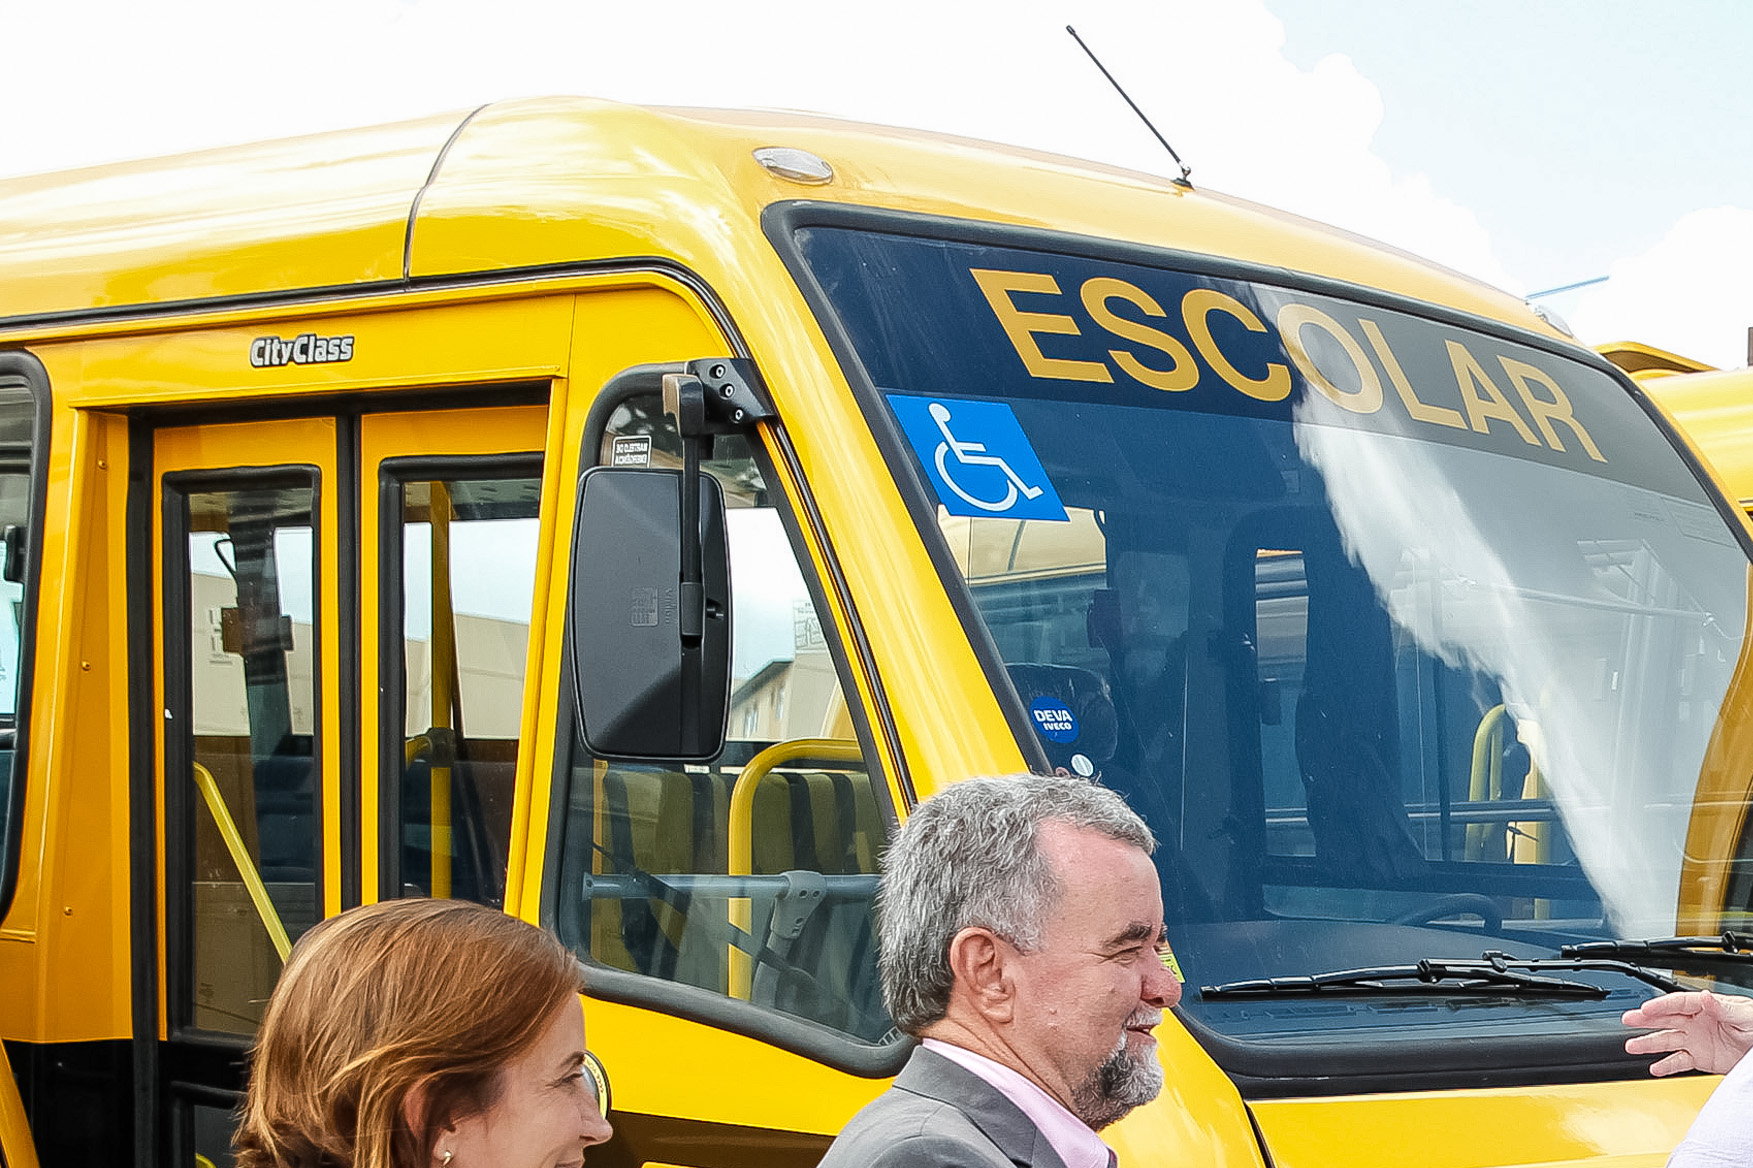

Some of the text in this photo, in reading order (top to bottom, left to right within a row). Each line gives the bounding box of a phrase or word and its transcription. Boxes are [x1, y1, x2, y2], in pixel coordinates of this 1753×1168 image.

[250, 334, 355, 367] CityClass
[969, 267, 1608, 464] ESCOLAR
[1033, 709, 1074, 722] DEVA
[1042, 722, 1073, 731] IVECO
